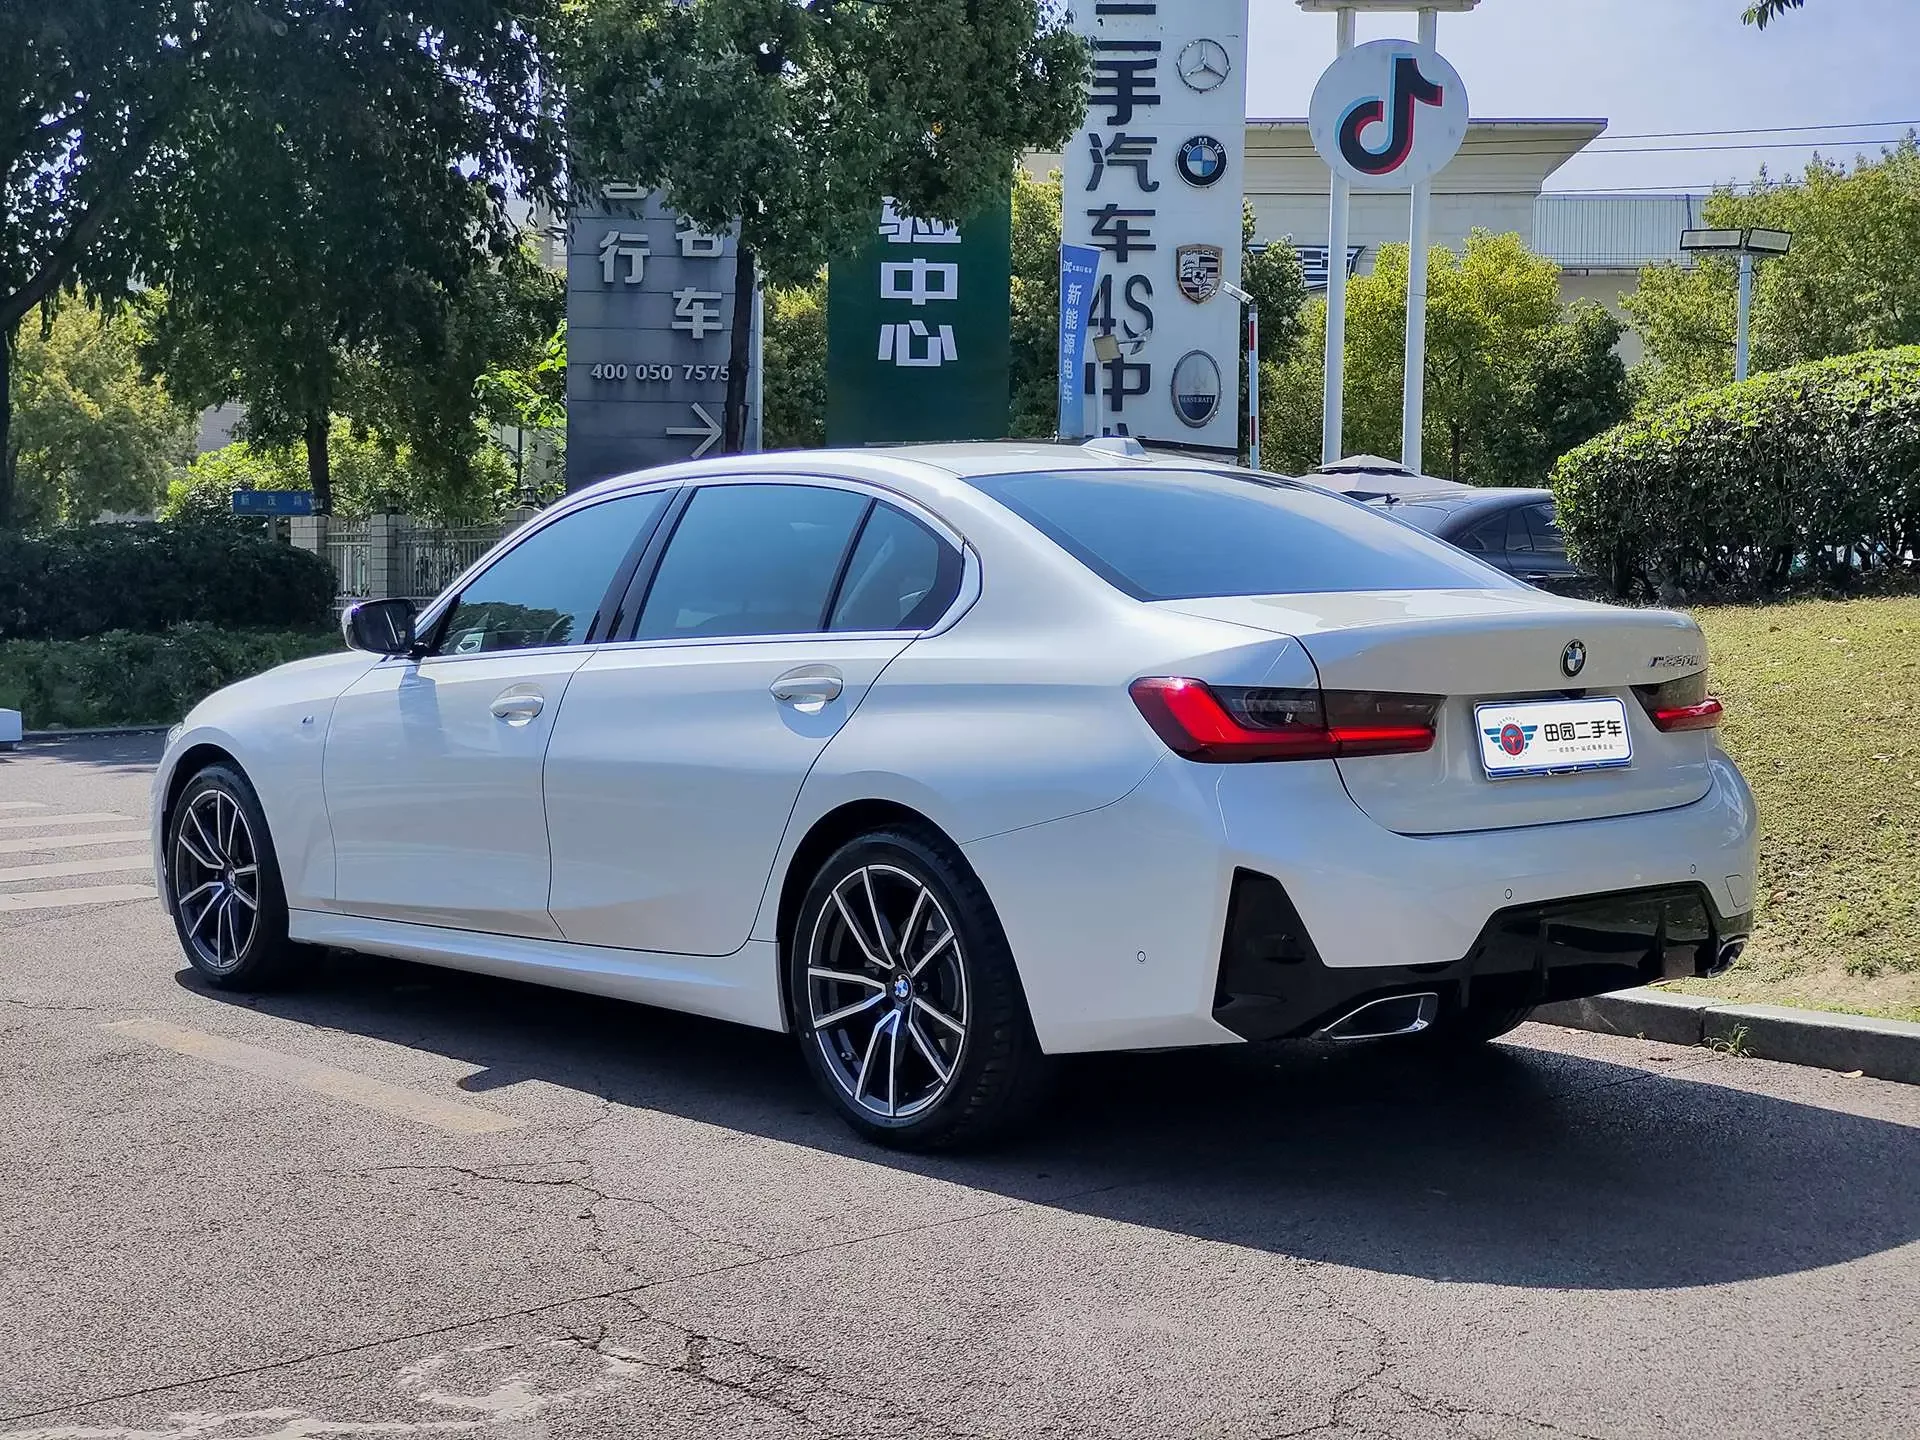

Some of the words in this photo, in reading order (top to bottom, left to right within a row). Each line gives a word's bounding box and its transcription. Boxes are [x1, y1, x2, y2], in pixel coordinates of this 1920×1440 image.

[1183, 137, 1224, 154] BMW
[1086, 4, 1162, 438] 二手汽车4S中
[590, 363, 628, 380] 400
[635, 364, 673, 381] 050
[682, 364, 730, 381] 7575
[1543, 719, 1623, 742] 田园二手车
